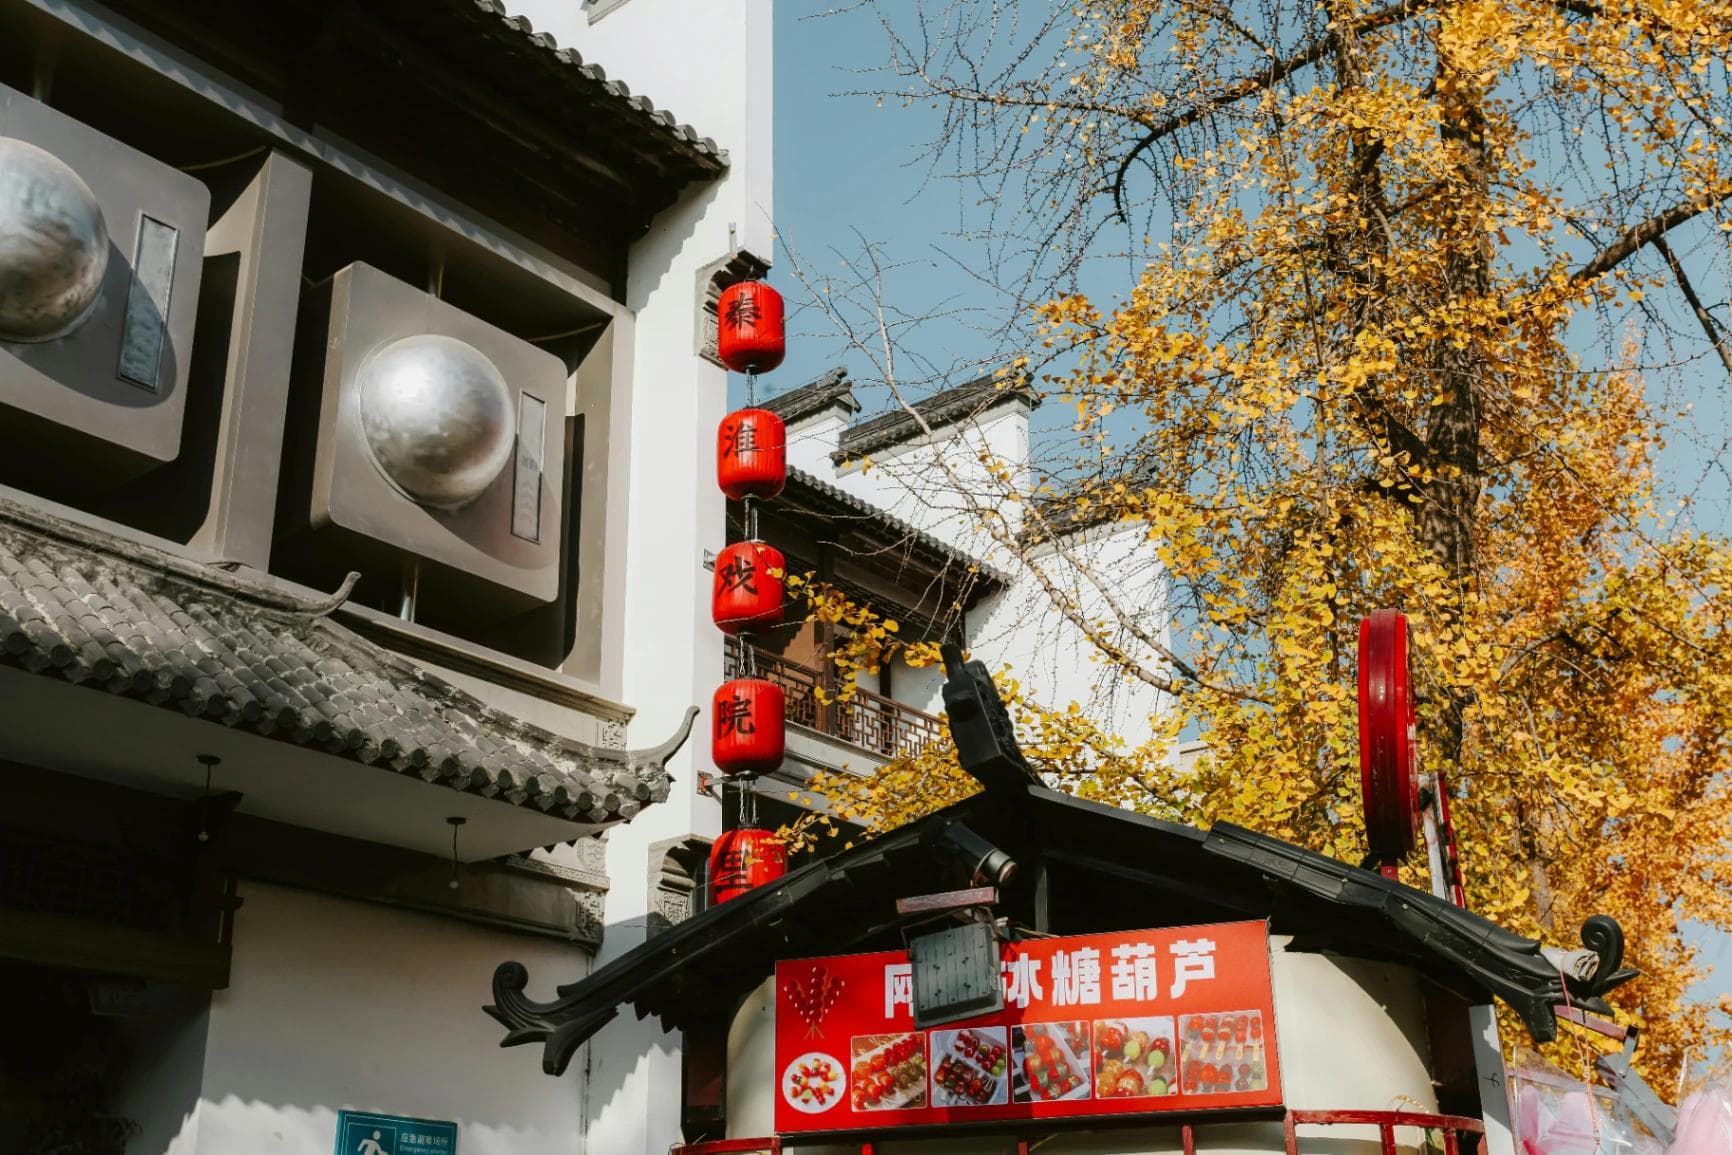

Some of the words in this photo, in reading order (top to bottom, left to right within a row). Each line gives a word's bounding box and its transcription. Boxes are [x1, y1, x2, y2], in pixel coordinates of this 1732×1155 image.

[716, 291, 762, 890] 秦淮戏院里
[885, 938, 1216, 1016] 网冰糖葫芦
